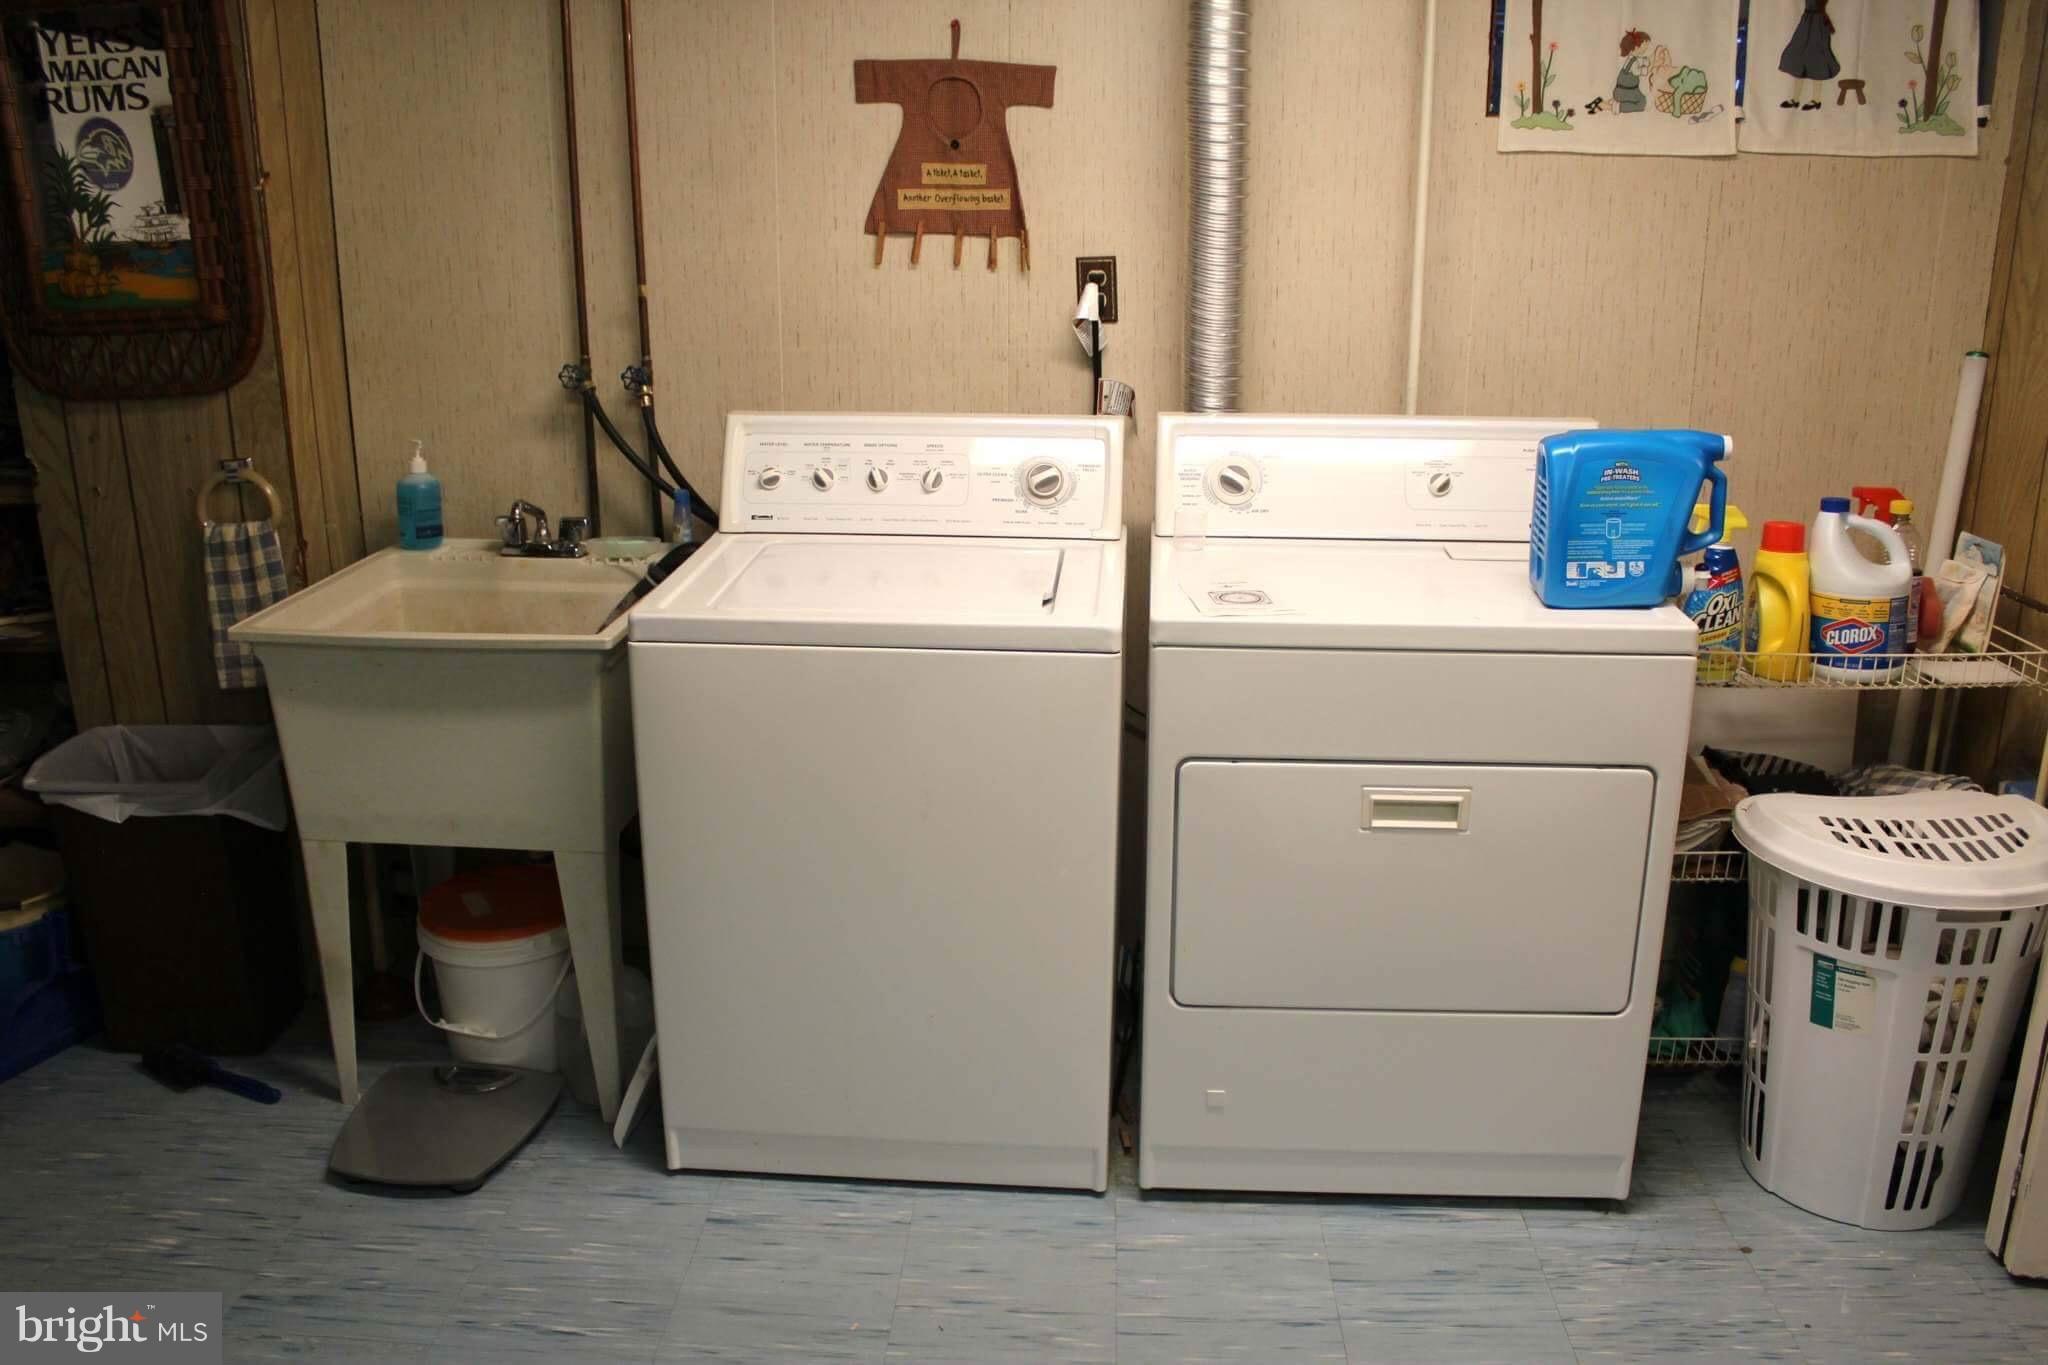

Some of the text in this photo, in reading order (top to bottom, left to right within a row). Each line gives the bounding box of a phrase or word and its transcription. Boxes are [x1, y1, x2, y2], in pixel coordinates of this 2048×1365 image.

[41, 83, 149, 114] RUMS
[903, 192, 931, 202] Another
[934, 192, 980, 206] Overflowing
[1603, 467, 1639, 476] IN-WASH
[1707, 594, 1737, 616] OXI
[1696, 608, 1741, 633] CLEAN
[1826, 624, 1878, 645] CLOROX
